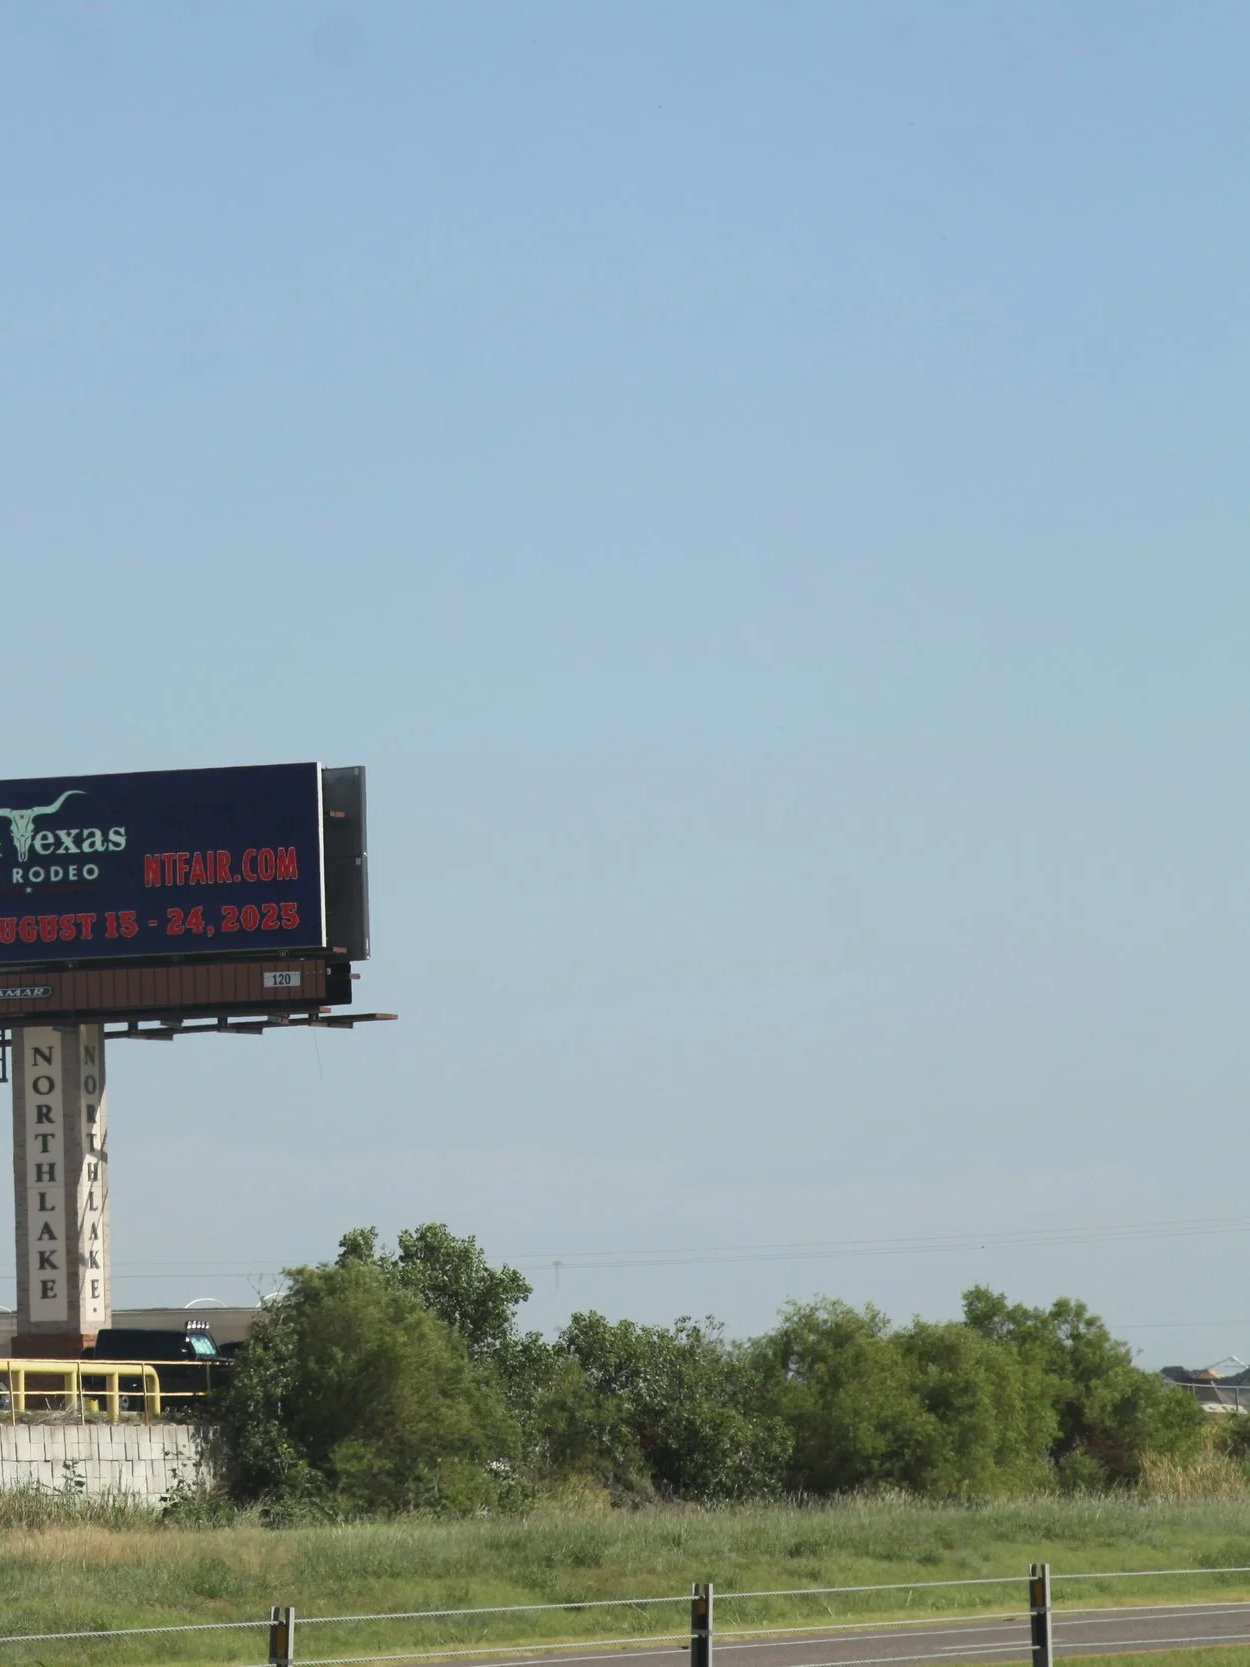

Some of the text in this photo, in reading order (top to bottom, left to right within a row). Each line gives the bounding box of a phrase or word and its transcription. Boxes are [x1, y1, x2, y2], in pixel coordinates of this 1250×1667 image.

[12, 863, 99, 884] RODEO
[144, 846, 298, 888] NTFAIR.COM
[105, 910, 139, 938] 15
[166, 905, 215, 938] 24,
[221, 901, 301, 932] 2025
[272, 973, 292, 986] 120
[31, 1046, 60, 1300] NORTHLAKE
[83, 1046, 101, 1300] NORTHLAKE
